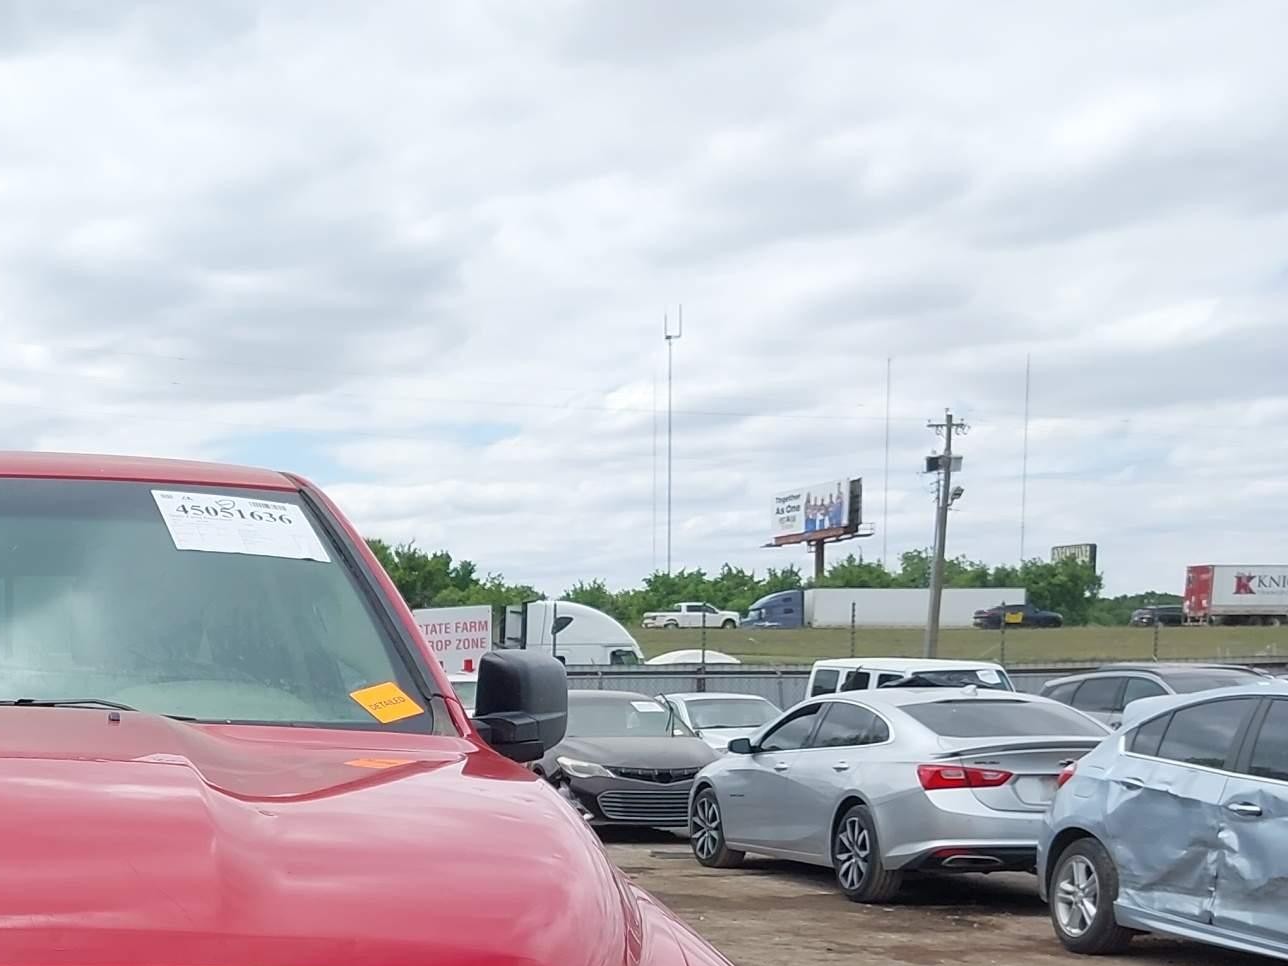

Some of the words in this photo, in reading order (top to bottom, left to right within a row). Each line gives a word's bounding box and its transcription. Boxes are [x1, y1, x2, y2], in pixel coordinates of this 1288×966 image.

[175, 504, 293, 526] 45051636
[1257, 575, 1288, 588] KNI
[419, 622, 451, 635] TATE
[454, 620, 488, 633] FARM
[428, 639, 452, 652] ROP
[455, 637, 487, 650] ZONE
[368, 696, 406, 711] DETAILED
